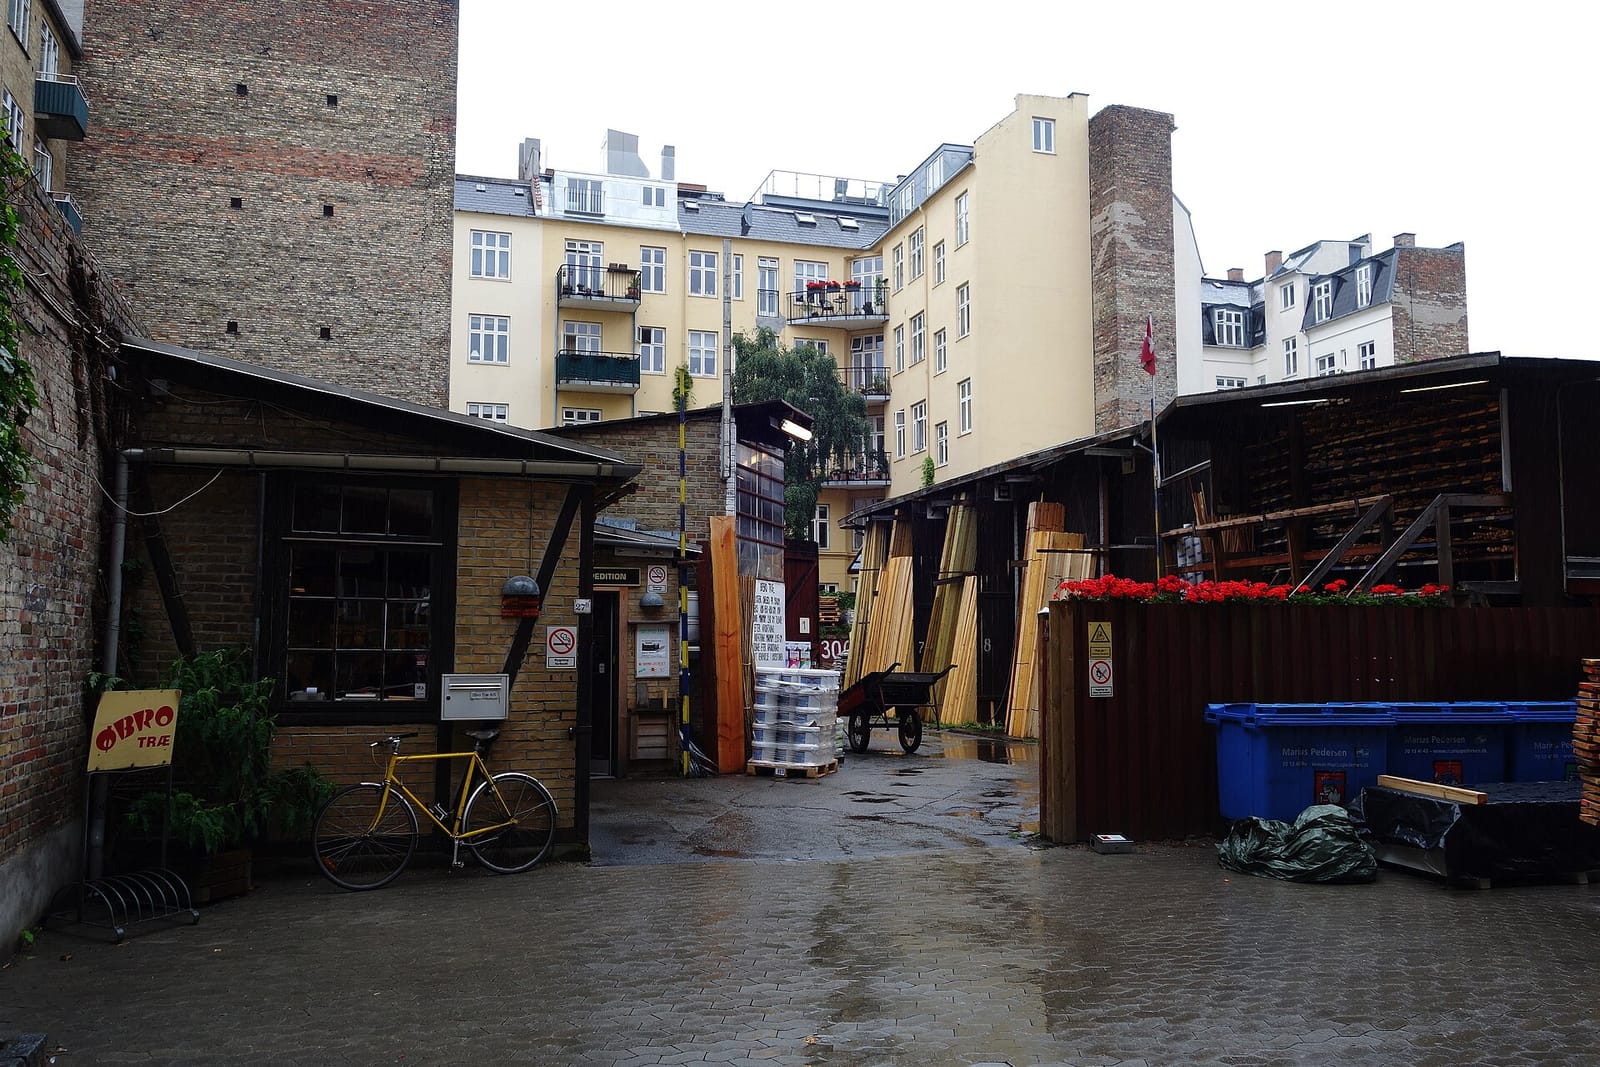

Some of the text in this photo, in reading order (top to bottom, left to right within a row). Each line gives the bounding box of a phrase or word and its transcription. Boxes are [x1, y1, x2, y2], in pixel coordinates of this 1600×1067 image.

[593, 573, 627, 581] EDITION
[918, 641, 925, 654] 7
[983, 638, 992, 652] 8
[96, 705, 174, 753] ØBRO
[137, 735, 171, 748] TRÆ
[1282, 747, 1347, 757] Marius Pedersen
